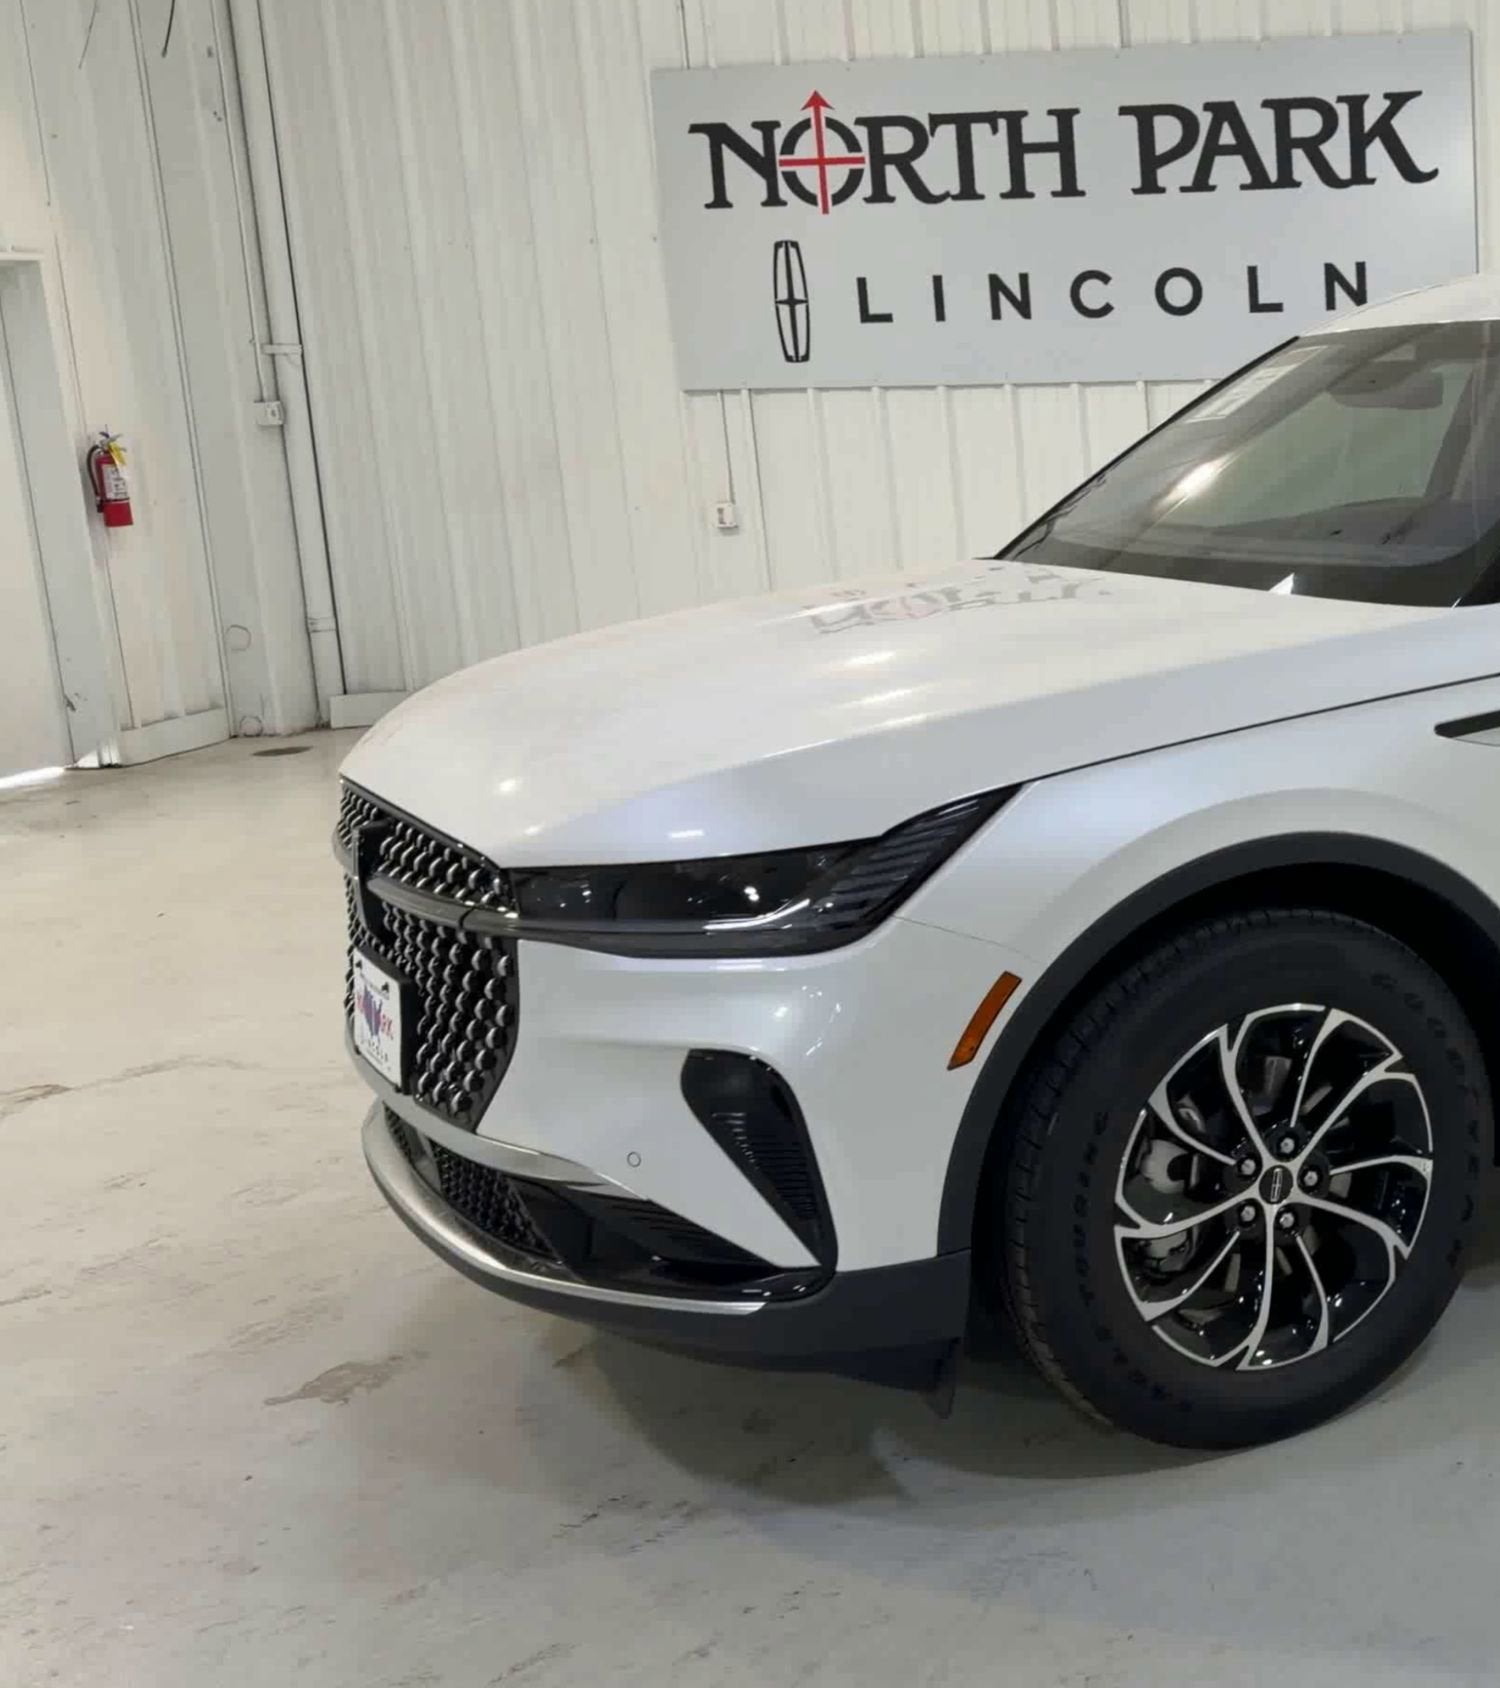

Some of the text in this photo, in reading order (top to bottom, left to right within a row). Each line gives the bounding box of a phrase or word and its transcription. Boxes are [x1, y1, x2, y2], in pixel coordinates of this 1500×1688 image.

[688, 90, 1440, 210] NORTH PARK
[857, 261, 1369, 324] LINCOLN
